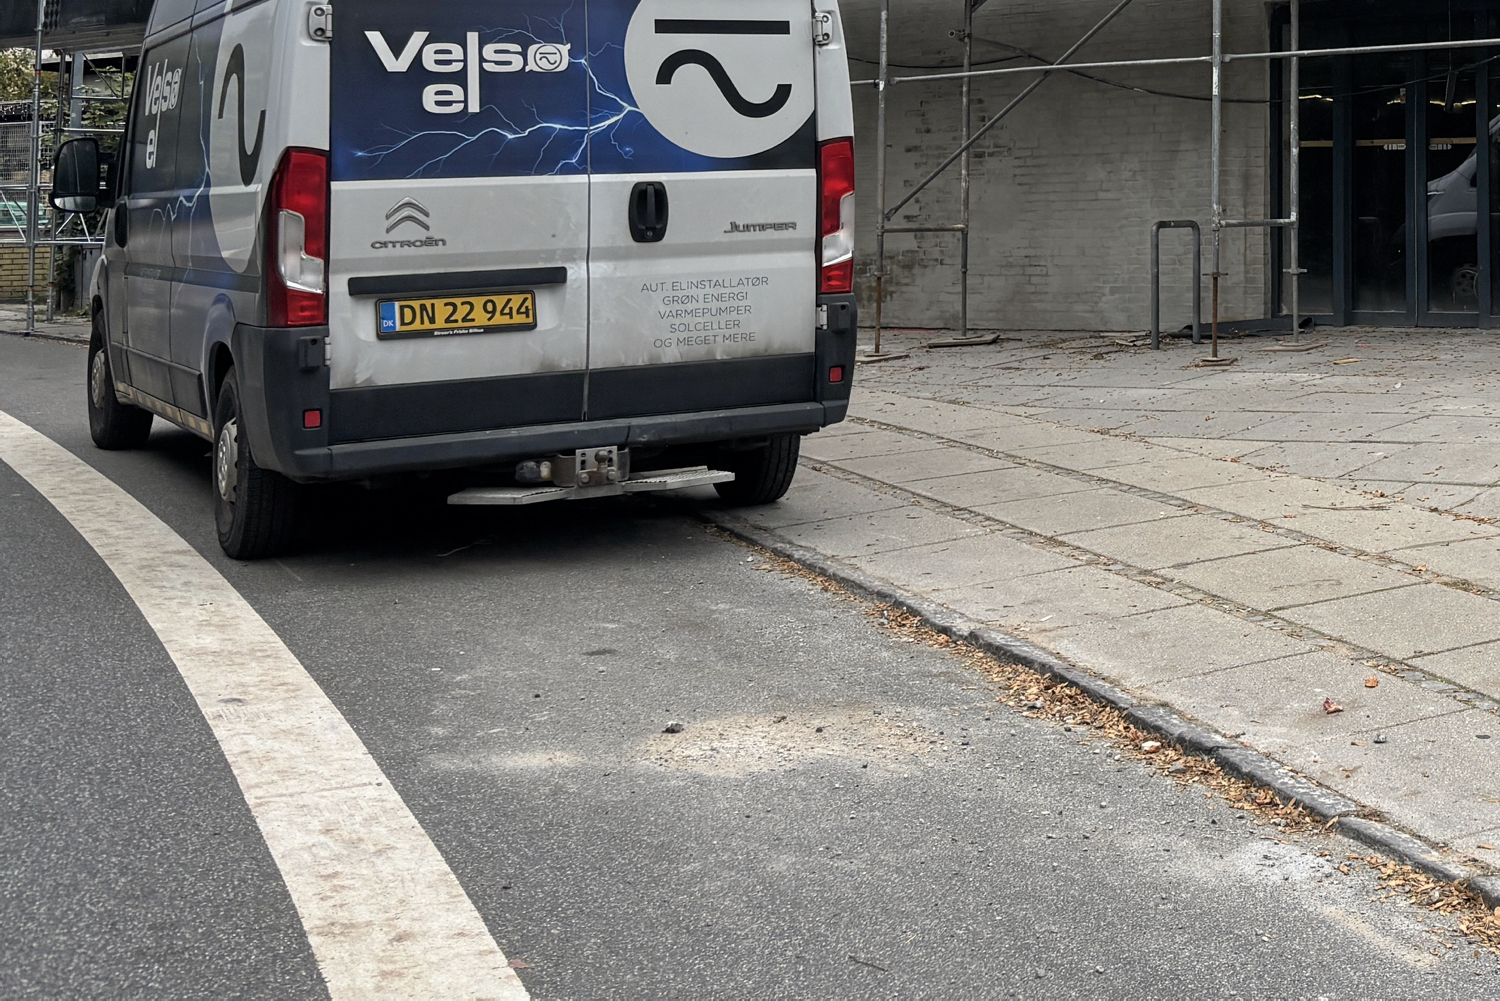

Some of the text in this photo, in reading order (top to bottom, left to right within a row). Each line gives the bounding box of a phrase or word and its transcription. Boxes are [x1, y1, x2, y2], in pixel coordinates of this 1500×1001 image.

[422, 82, 481, 114] el
[723, 221, 797, 234] JUMPER
[640, 276, 769, 293] AUT. ELINSTALLATØR
[662, 291, 749, 306] GRØN ENERGI
[400, 297, 531, 327] DN 22 944
[658, 304, 753, 320] VARMEPUMPER
[383, 320, 394, 328] DK
[669, 319, 741, 334] SOLCELLER
[653, 331, 757, 349] OG MEGET MERE
